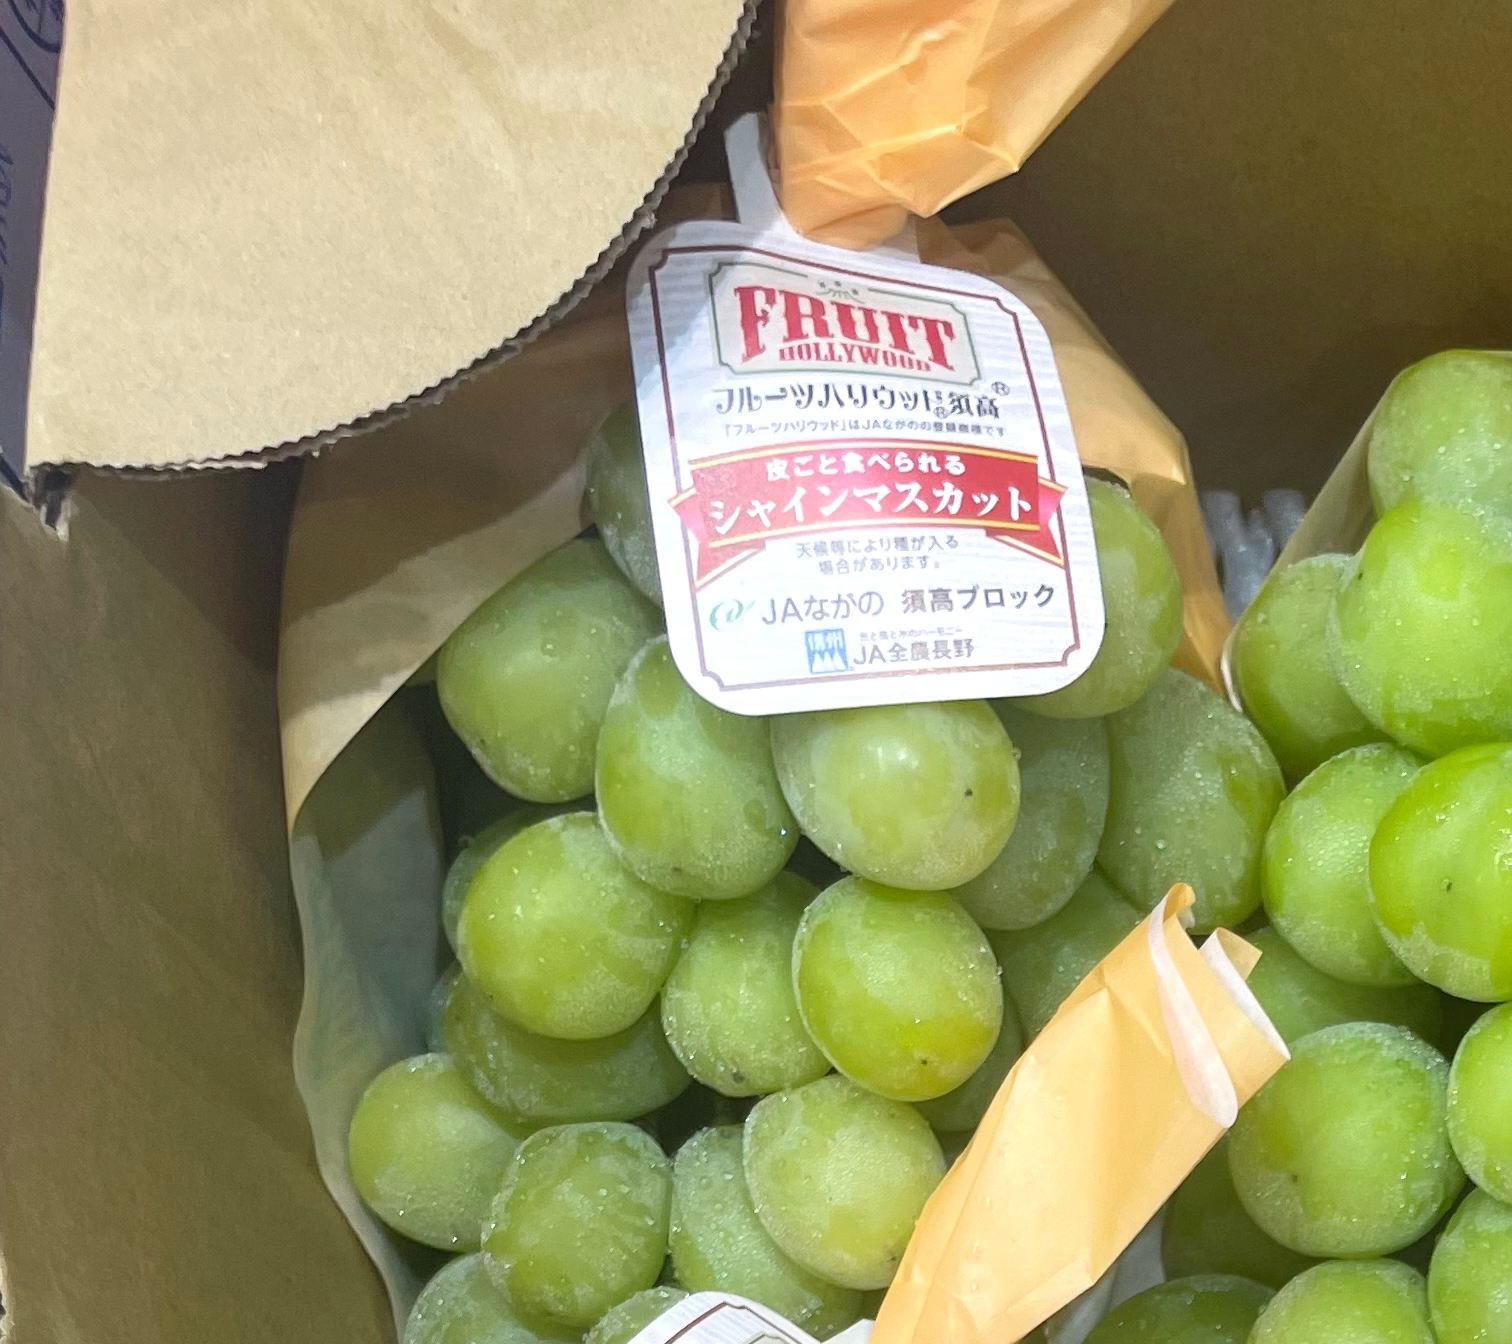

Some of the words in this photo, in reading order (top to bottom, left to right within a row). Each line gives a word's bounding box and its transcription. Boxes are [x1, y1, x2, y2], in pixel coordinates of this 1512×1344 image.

[734, 286, 955, 371] FRUIT
[779, 343, 931, 371] HOLLYWOOD
[765, 452, 966, 482] 皮ごと食べられる
[709, 482, 1032, 534] シャインマスカット
[761, 592, 884, 625] JAながの
[902, 585, 1055, 615] 須高ブロック
